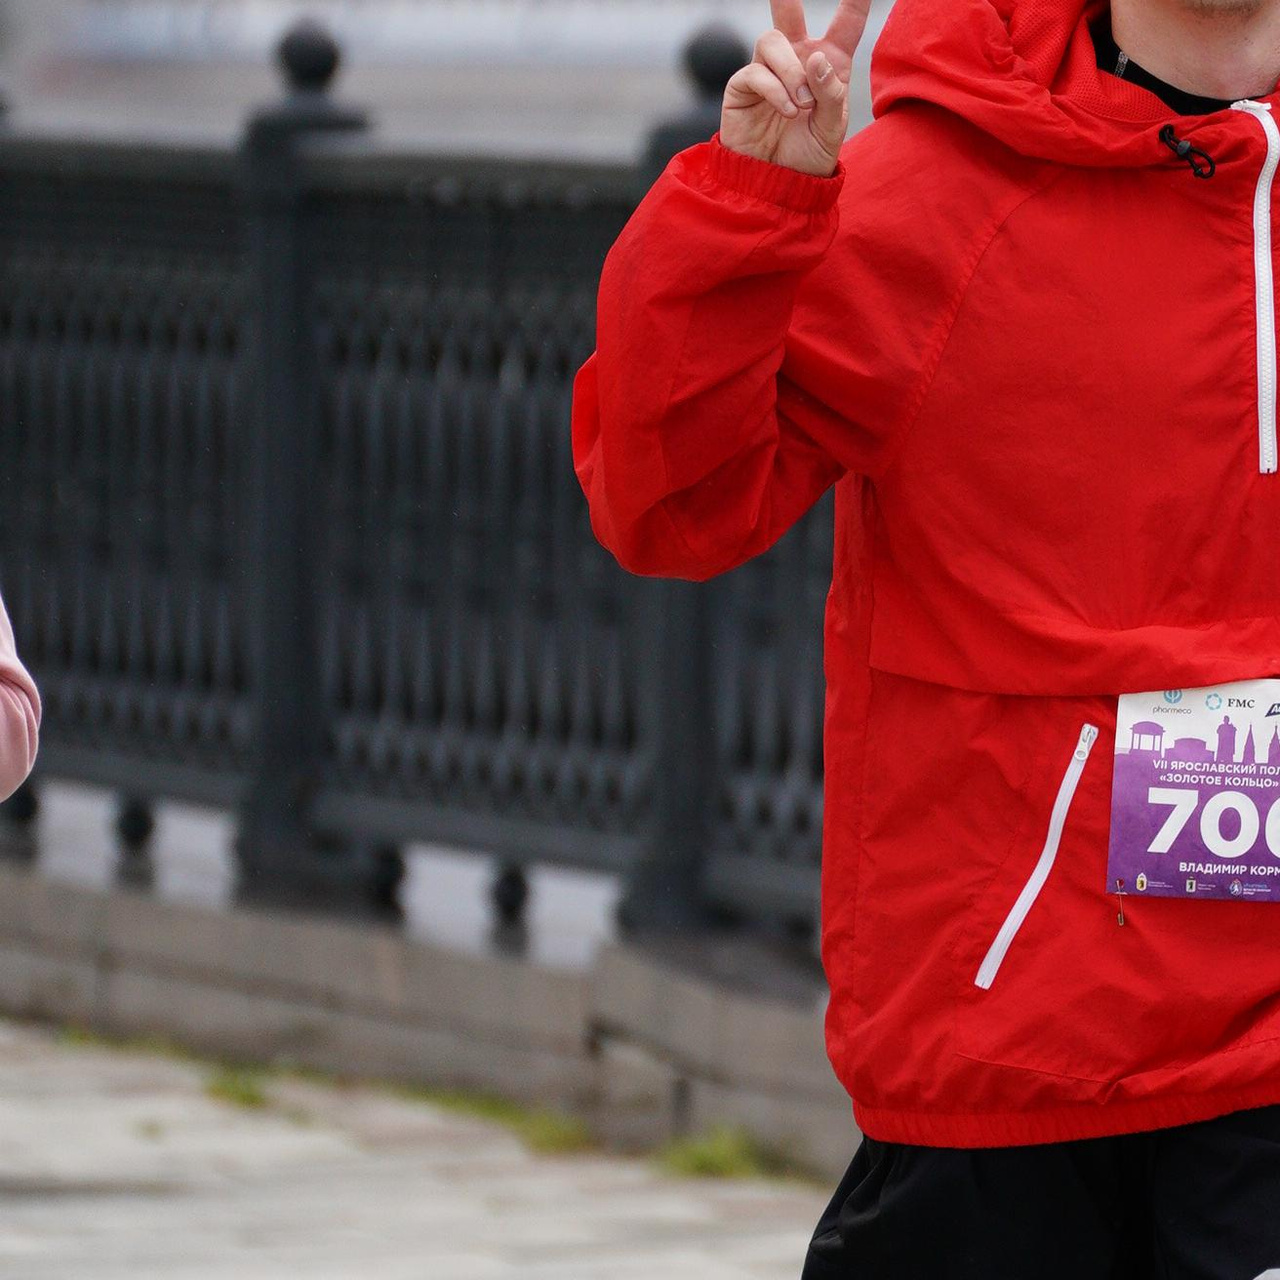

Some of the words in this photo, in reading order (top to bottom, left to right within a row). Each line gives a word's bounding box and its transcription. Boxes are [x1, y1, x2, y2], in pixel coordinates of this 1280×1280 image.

[1227, 698, 1256, 709] FMC
[1152, 760, 1168, 770] VII
[1170, 761, 1257, 775] ЯРОСЛАВСКИЙ
[1159, 773, 1221, 786] «ЗОЛОТОЕ
[1225, 776, 1279, 789] КОЛЬЦО»
[1179, 862, 1248, 876] ВЛАДИМИР
